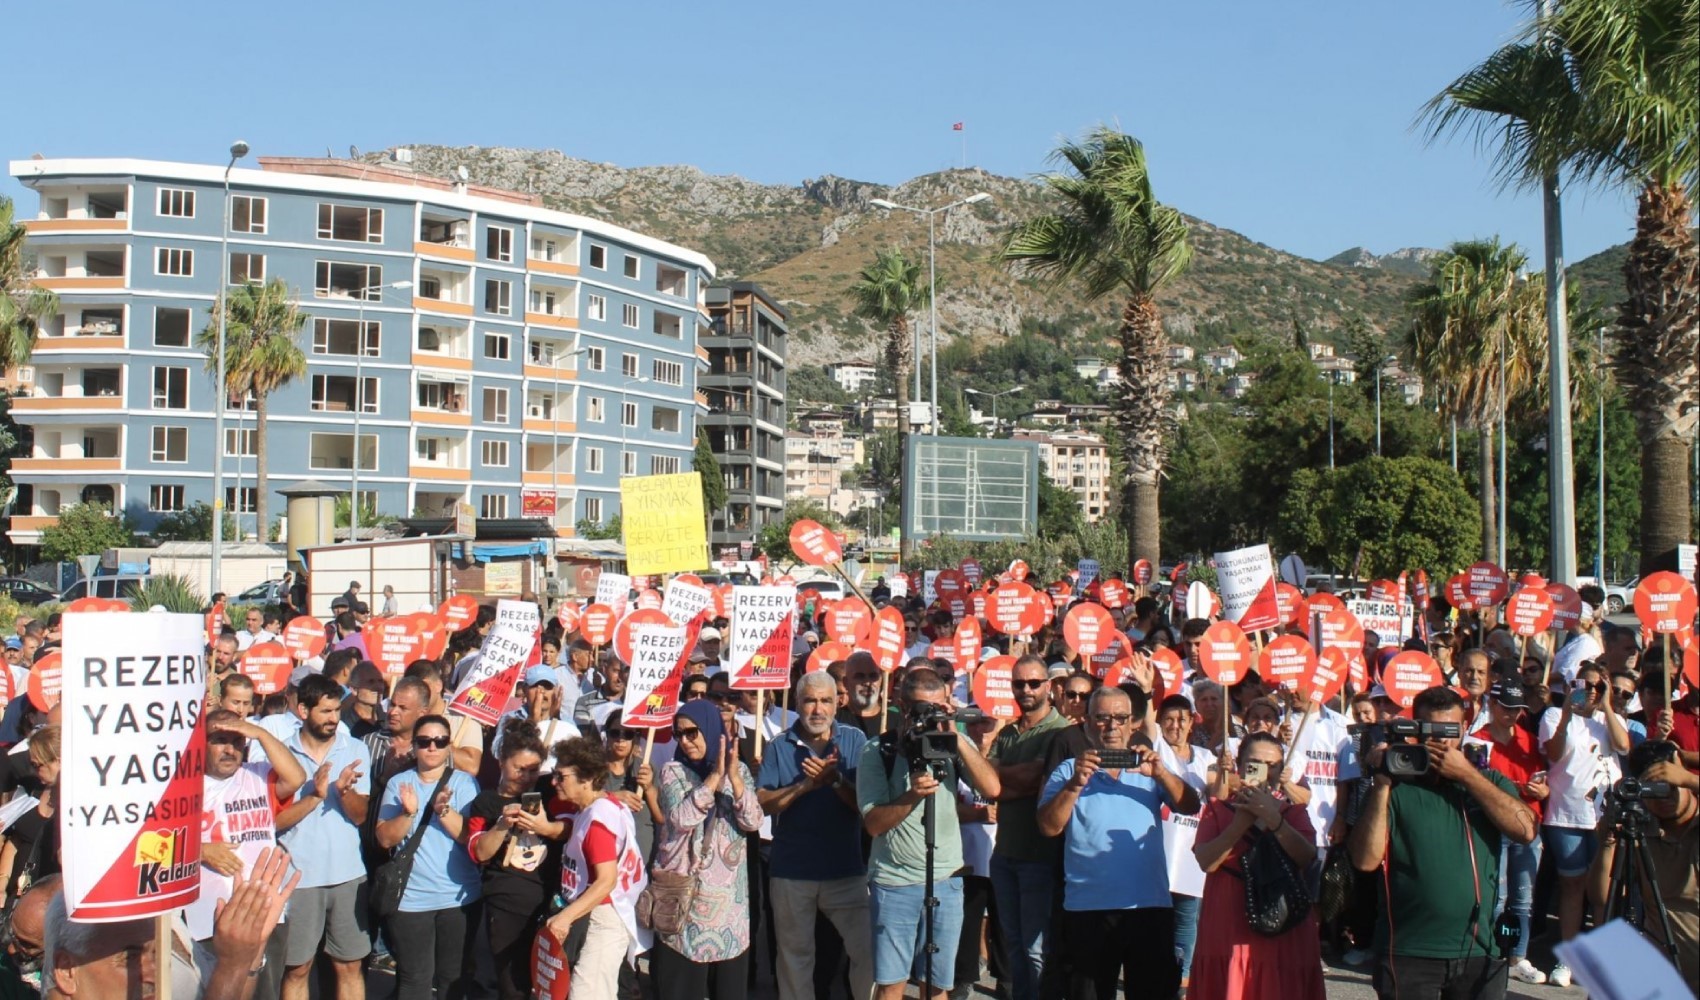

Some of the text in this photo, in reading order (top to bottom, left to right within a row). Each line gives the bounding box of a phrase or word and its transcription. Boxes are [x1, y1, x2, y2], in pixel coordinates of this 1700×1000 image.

[739, 595, 792, 607] REZERV
[500, 609, 537, 621] REZER
[740, 626, 790, 640] YAĞMA
